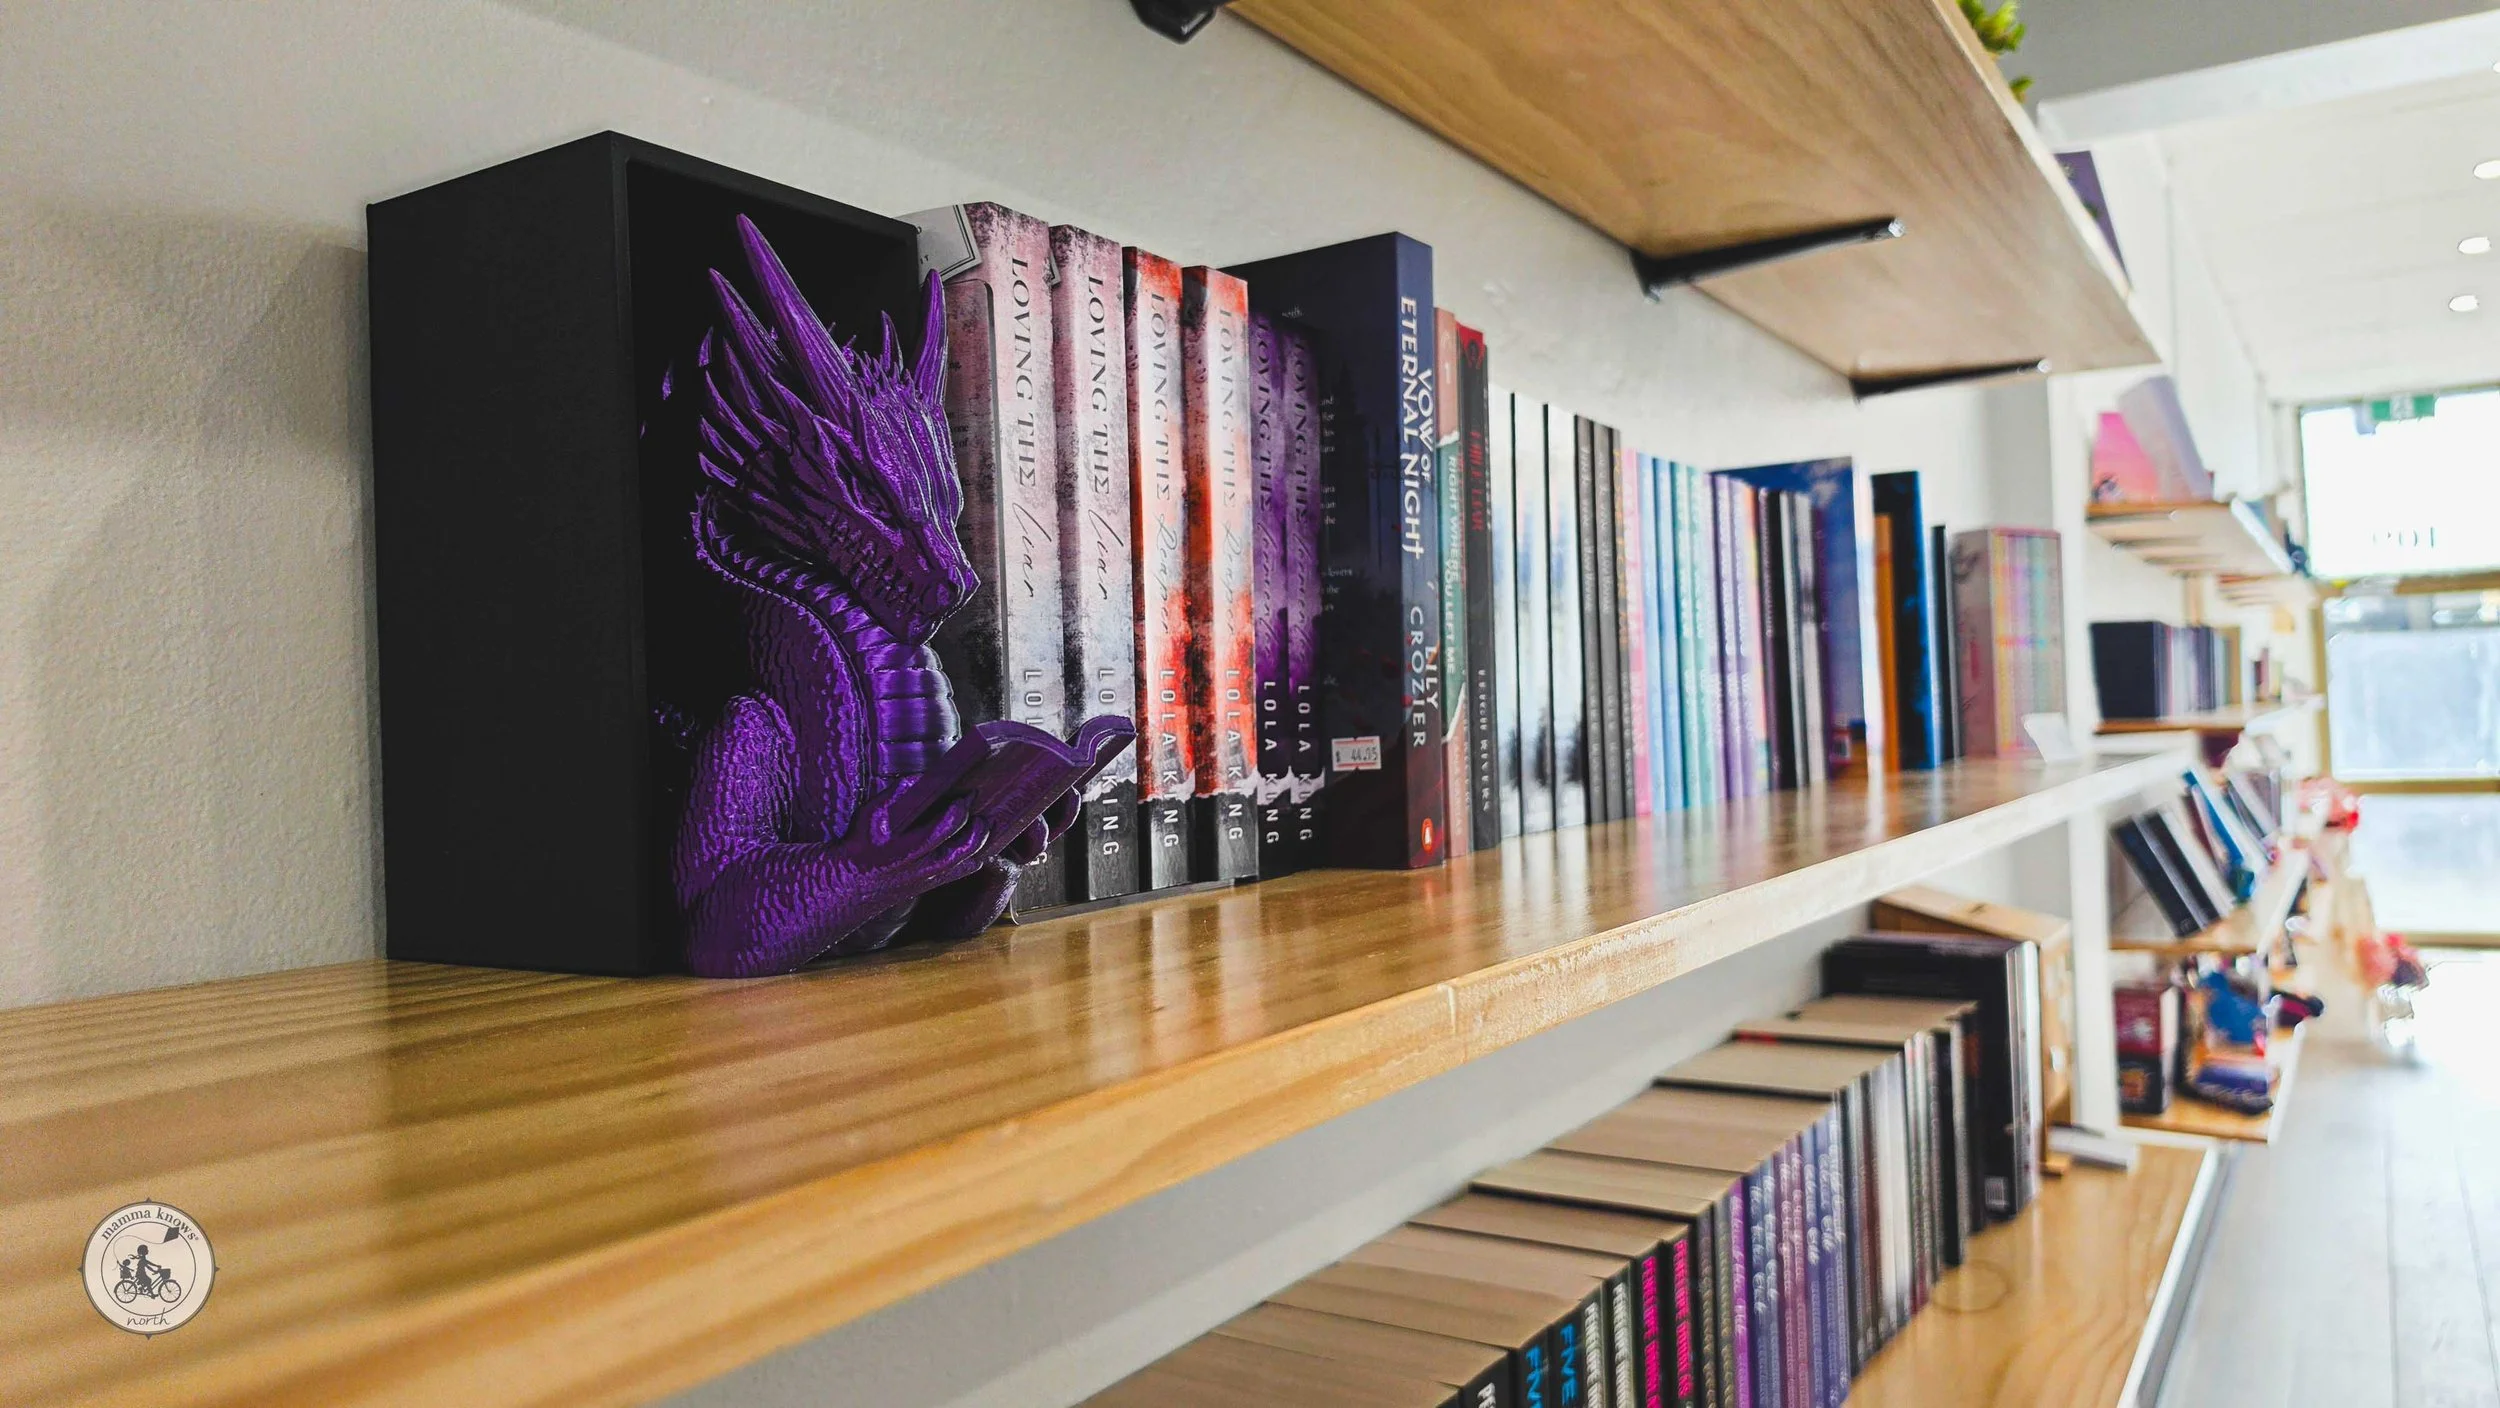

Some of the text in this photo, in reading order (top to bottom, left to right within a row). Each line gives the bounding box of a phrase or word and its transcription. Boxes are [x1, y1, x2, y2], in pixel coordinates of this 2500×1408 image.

[1151, 293, 1168, 422] LOVING
[1218, 309, 1234, 432] LOVING
[1257, 321, 1272, 441] LOVING
[1294, 341, 1309, 455] LOVING
[1011, 257, 1052, 597] LOVING THE Liar
[1088, 275, 1124, 600] LOVING THE Liar
[1154, 437, 1170, 500] THE
[1221, 443, 1236, 508] THE
[1259, 450, 1273, 514] THE
[1400, 296, 1425, 561] ETERNAL NIGHT
[1417, 368, 1434, 483] VOW OF
[1295, 463, 1309, 524] THE
[1448, 456, 1460, 584] RIGHT WHERE
[1409, 605, 1427, 747] CROZIER
[1444, 558, 1456, 675] YOU LEFT ME
[1424, 646, 1440, 710] LILY
[1101, 773, 1119, 857] KING
[1160, 669, 1179, 848] LOLA KING
[1225, 669, 1244, 841] LOLA KING
[1263, 681, 1279, 845] LOLA KING
[1298, 685, 1313, 841] LOLA KING
[1642, 1256, 1659, 1341] PENELOPE
[1673, 1239, 1690, 1321] PENELOPE
